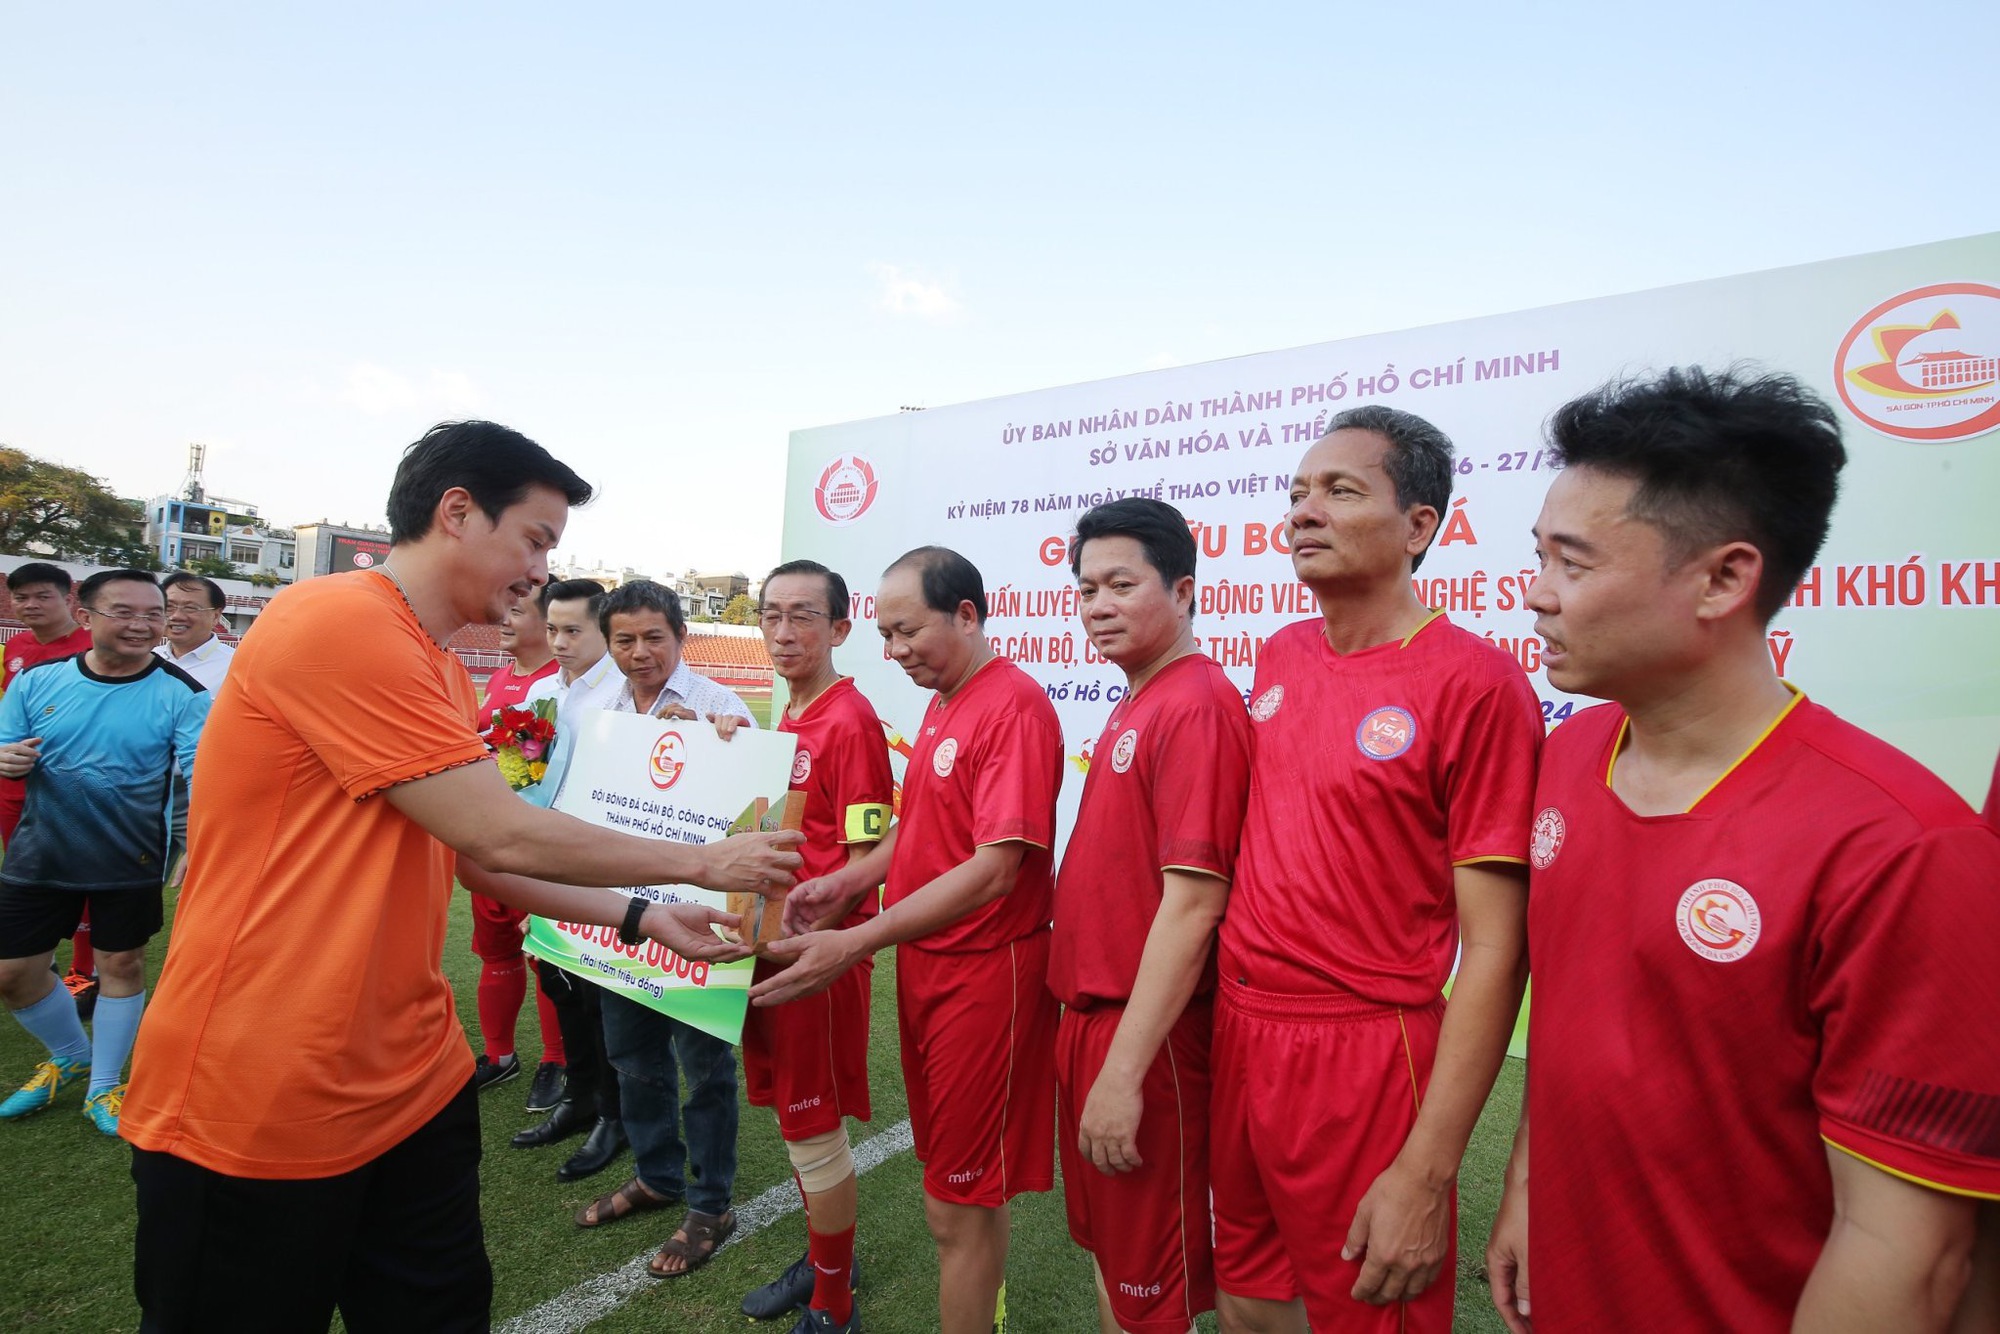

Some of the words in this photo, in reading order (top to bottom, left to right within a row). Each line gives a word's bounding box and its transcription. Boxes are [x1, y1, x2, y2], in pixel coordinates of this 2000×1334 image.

[1003, 423, 1026, 445] ỦY
[1032, 420, 1072, 441] BAN
[1078, 409, 1138, 435] NHÂN
[1144, 401, 1193, 426] DÂN
[1200, 390, 1282, 418] THÀNH
[1291, 371, 1348, 406] PHỐ
[1357, 363, 1399, 397] HỒ
[1409, 356, 1466, 389] CHÍ
[1475, 349, 1559, 381] MINH
[1089, 440, 1118, 466] SỞ
[1124, 438, 1170, 461] VĂN
[1178, 429, 1230, 456] HÓA
[1238, 422, 1273, 449] VÀ
[1281, 409, 1328, 444] THỂ
[947, 500, 966, 520] KỶ
[970, 499, 1006, 520] NIỆM
[1011, 499, 1029, 514] 78
[1034, 493, 1072, 512] NĂM
[1077, 487, 1126, 509] NGÀY
[1169, 480, 1220, 500] THAO
[1227, 473, 1268, 498] VIỆT
[1438, 496, 1478, 547] Á
[985, 584, 1019, 618] UẤN
[1200, 578, 1263, 621] ĐỘNG
[1412, 570, 1487, 618] NGHỆ
[1837, 555, 1925, 606] KHÓ
[1941, 562, 2000, 605] KH
[1006, 631, 1042, 663] CÁN
[1048, 631, 1079, 669] BỘ,
[1074, 680, 1100, 702] Hồ
[1540, 700, 1574, 722] 24
[1372, 718, 1406, 743] VSA
[605, 791, 627, 807] BÓNG
[628, 797, 640, 810] ĐÁ
[641, 798, 661, 815] CÁN
[677, 808, 705, 826] CÔNG
[863, 808, 881, 835] C
[605, 811, 632, 826] THÀNH
[631, 817, 650, 832] PHỐ
[664, 827, 682, 840] CHÍ
[682, 830, 706, 845] MINH
[579, 953, 597, 968] (Hai
[789, 1096, 820, 1113] mitre
[1120, 1283, 1160, 1298] mitre
